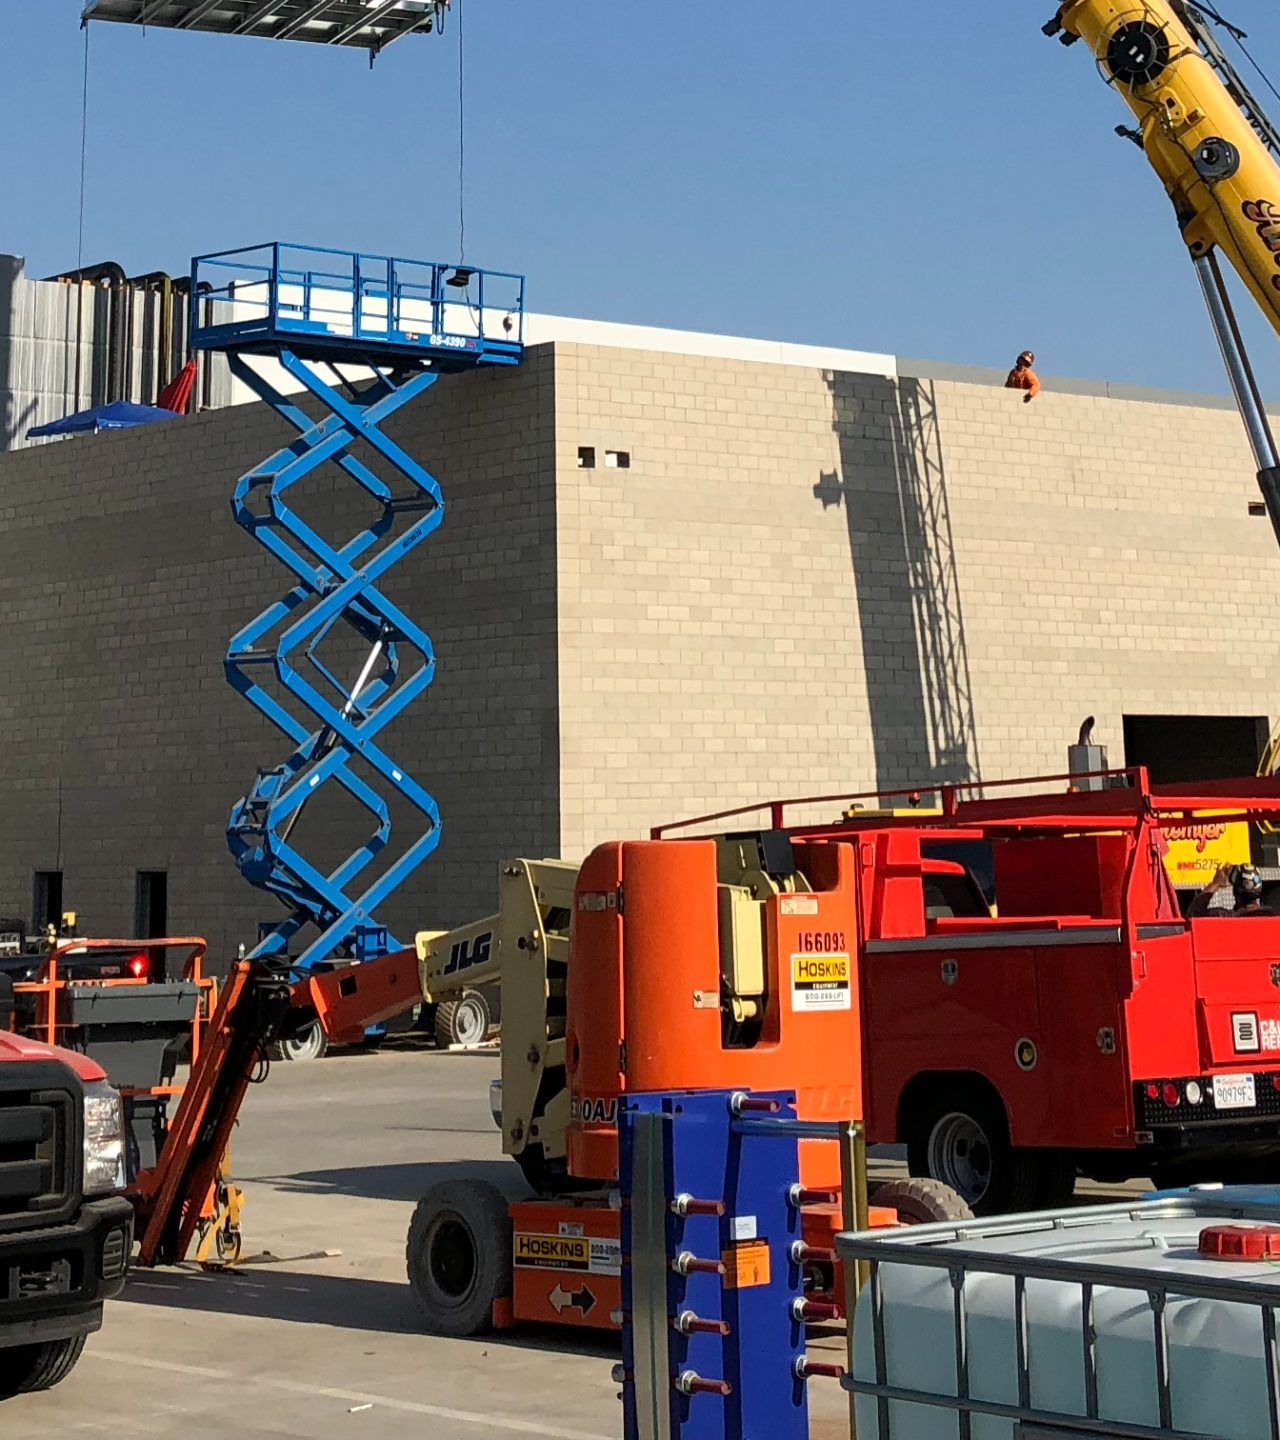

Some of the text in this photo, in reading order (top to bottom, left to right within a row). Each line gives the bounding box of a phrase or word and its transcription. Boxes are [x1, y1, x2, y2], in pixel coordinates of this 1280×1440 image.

[429, 334, 466, 348] GS-4390
[798, 932, 846, 953] 166093
[443, 931, 493, 976] JLG
[798, 961, 847, 977] HOSKINS
[519, 1237, 585, 1258] HOSKINS
